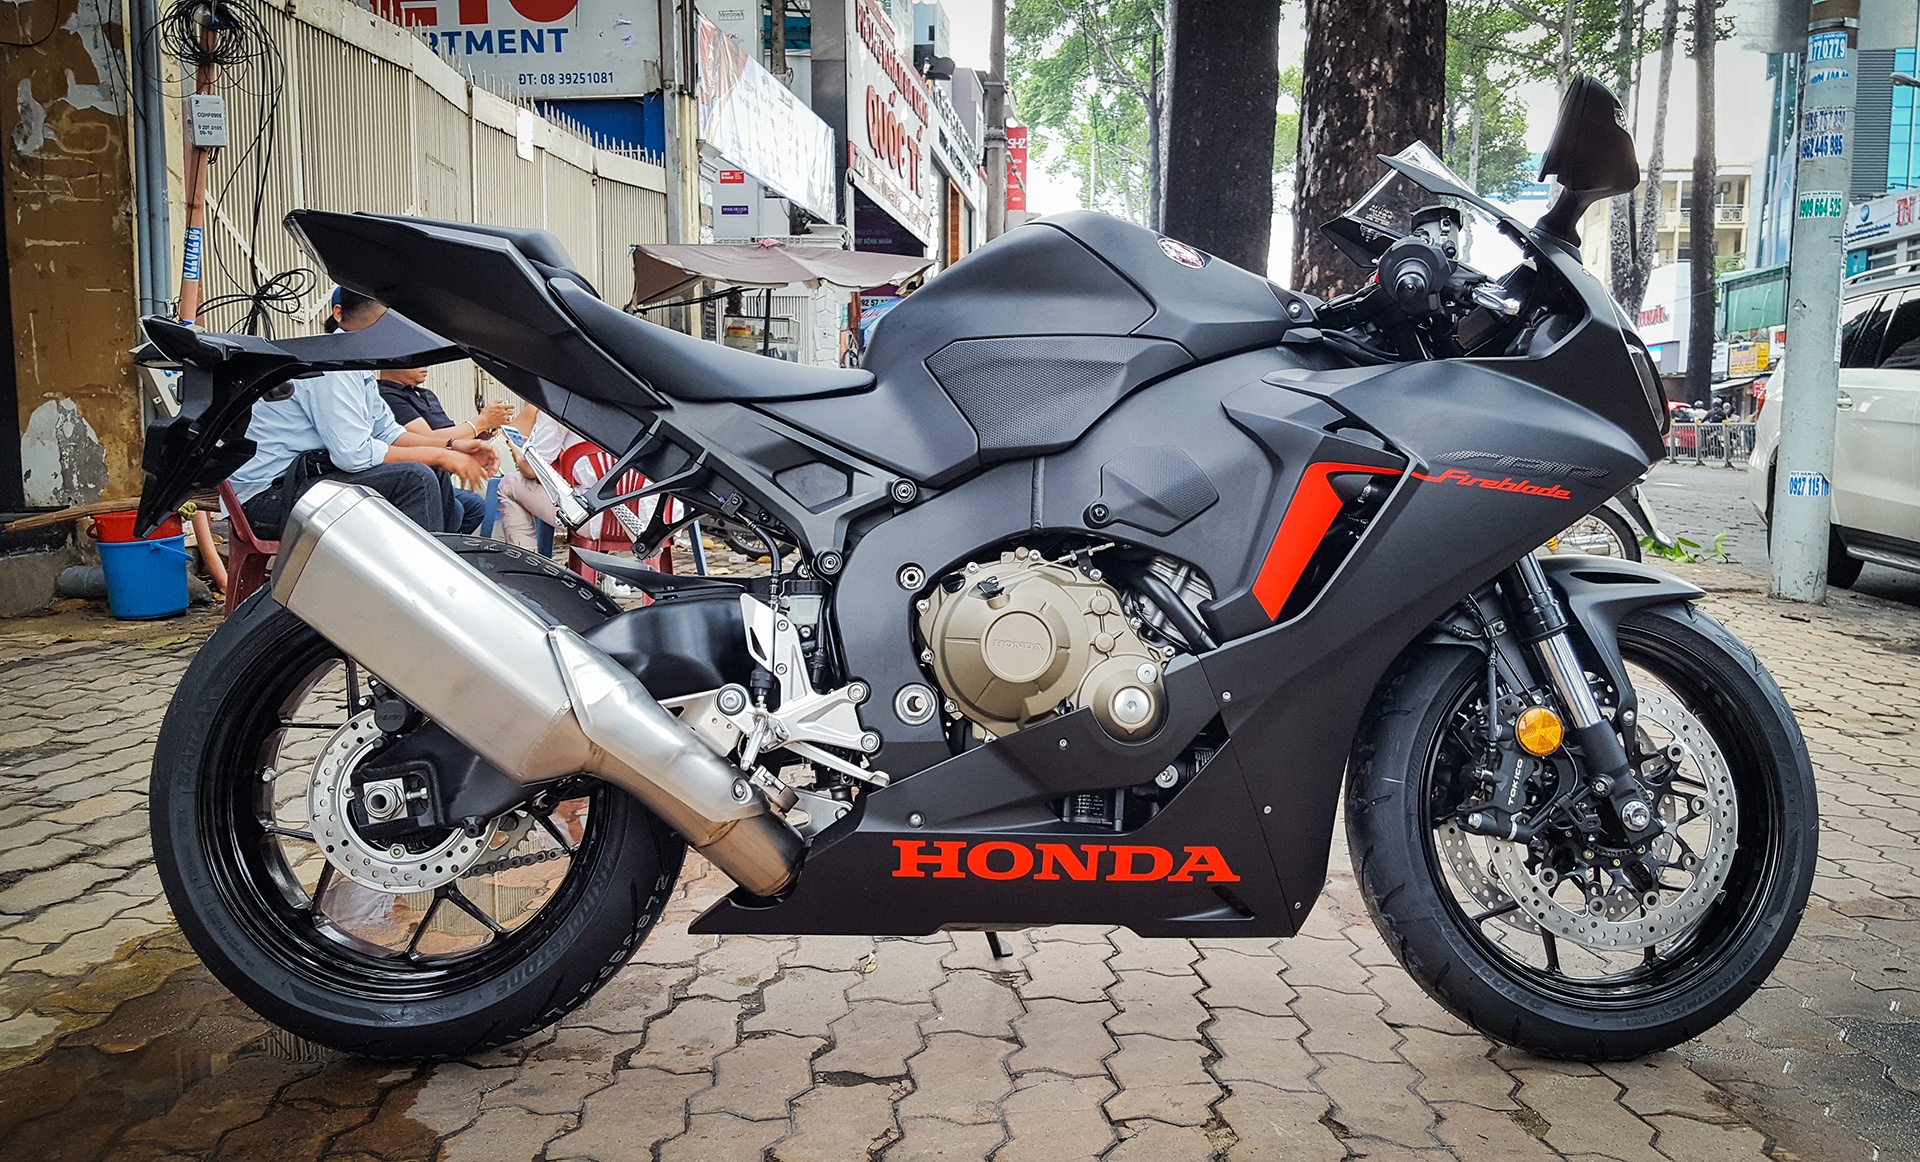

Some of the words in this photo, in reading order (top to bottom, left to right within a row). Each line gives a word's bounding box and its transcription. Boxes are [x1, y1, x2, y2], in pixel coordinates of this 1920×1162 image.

[421, 28, 569, 55] RTMENT
[540, 73, 555, 85] 08
[558, 72, 614, 85] 39251081
[1508, 758, 1524, 806] TOKICO
[892, 839, 1241, 882] HONDA
